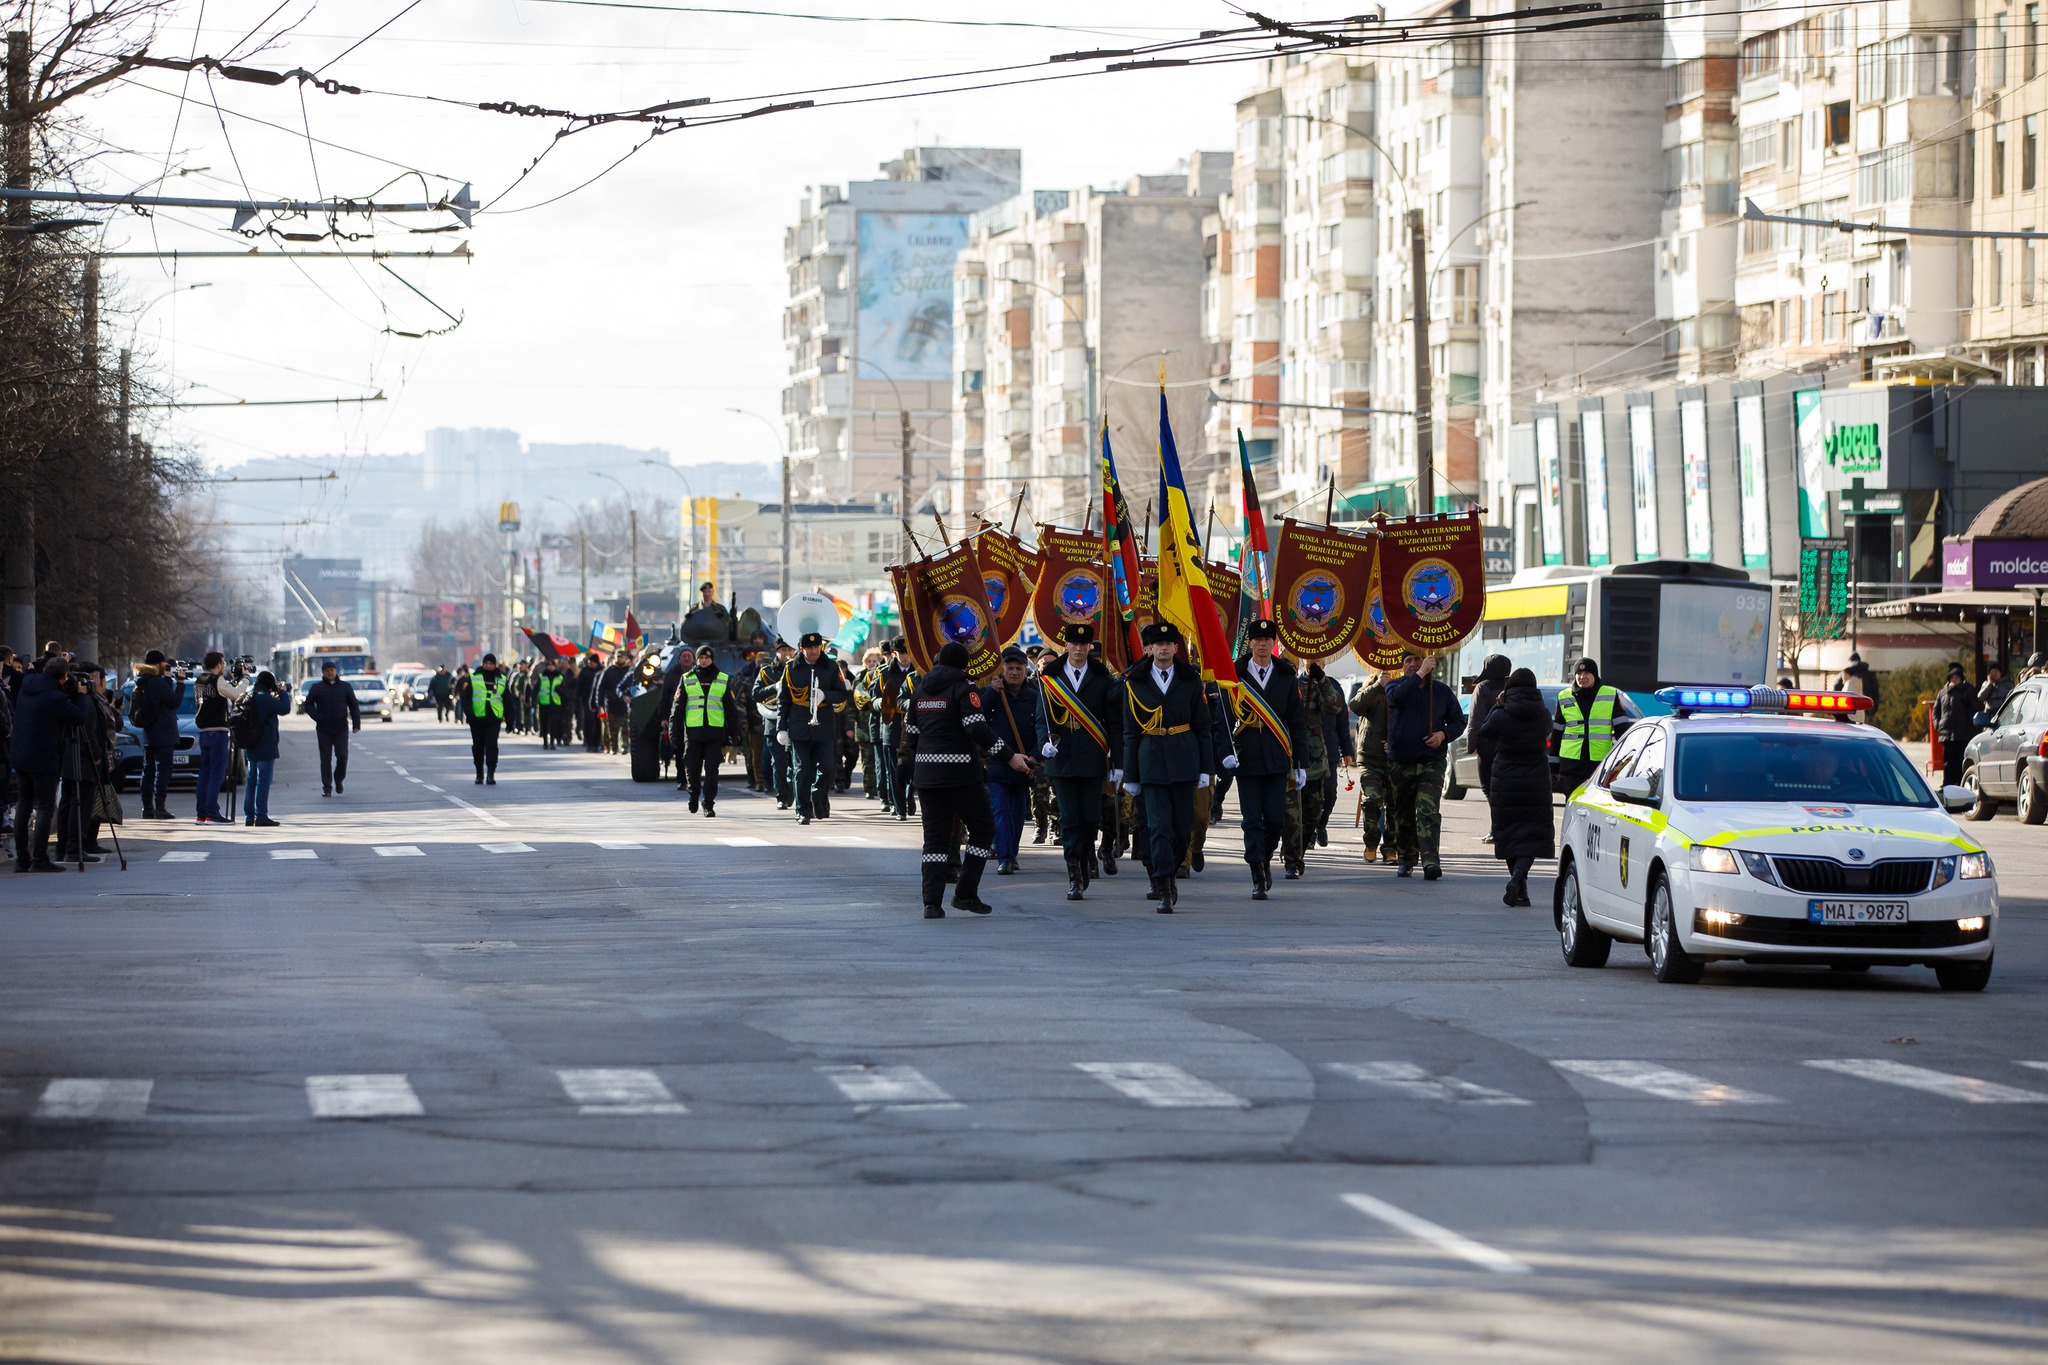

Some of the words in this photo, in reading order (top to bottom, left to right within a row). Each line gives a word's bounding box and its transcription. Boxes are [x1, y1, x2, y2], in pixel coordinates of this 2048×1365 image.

[1422, 525, 1471, 535] VETERANILOR
[1049, 538, 1079, 547] UNIUNEA
[1289, 532, 1319, 544] UNIUNEA
[1322, 538, 1368, 552] VETERANILOR
[1408, 543, 1451, 553] AFGANISTAN
[1305, 553, 1346, 566] AFGANISTAN
[1341, 550, 1356, 559] DIN
[926, 554, 969, 577] VETERANILOR
[949, 566, 964, 577] DIN
[1736, 595, 1766, 611] 935
[1276, 604, 1297, 649] BOTANICA
[1418, 621, 1452, 634] raionul
[1291, 631, 1327, 644] sectorul
[1411, 629, 1460, 644] CIMIȘLIA
[968, 652, 999, 676] OREȘTI
[1368, 652, 1403, 665] CRIULE
[917, 700, 947, 709] CARABINIERI
[1825, 904, 1855, 920] MAI
[1865, 904, 1905, 920] 9873
